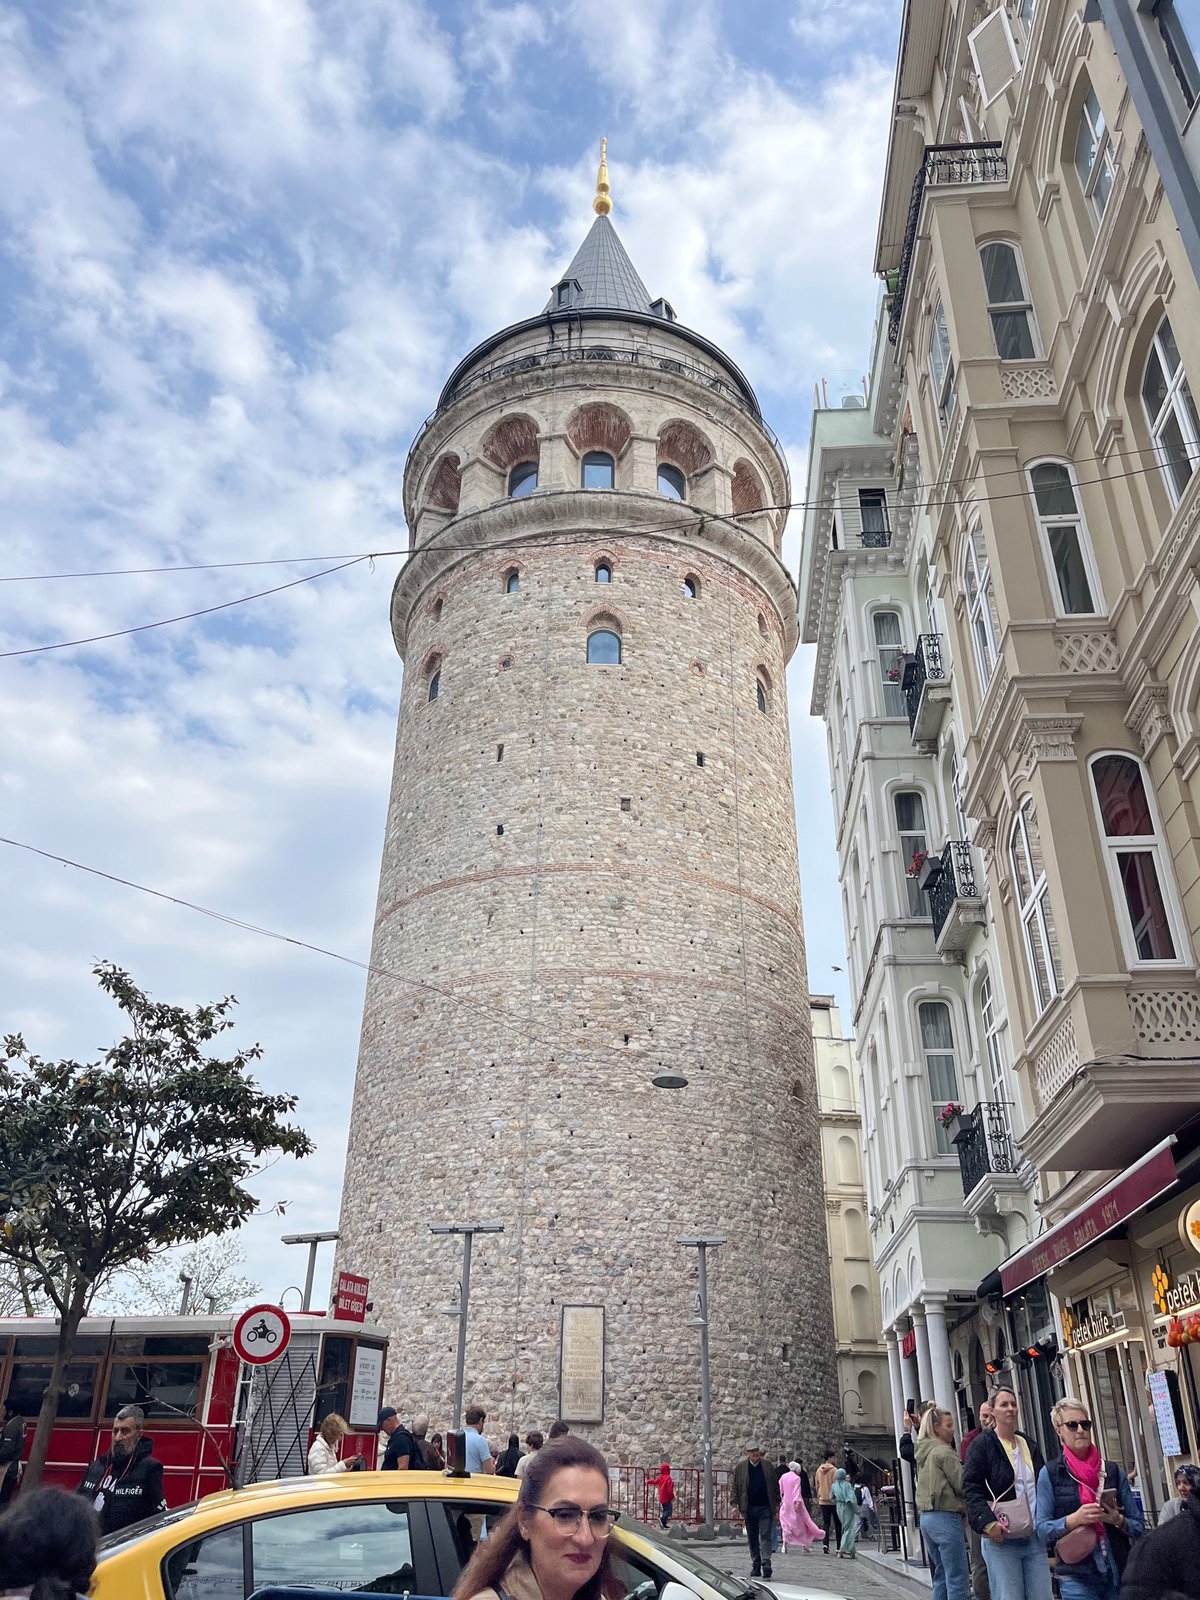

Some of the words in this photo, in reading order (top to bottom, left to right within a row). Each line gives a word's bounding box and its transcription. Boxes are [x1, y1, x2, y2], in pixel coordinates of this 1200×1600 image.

[1032, 1250, 1049, 1275] PETEK
[1074, 1217, 1099, 1247] GALATA
[1101, 1199, 1120, 1226] 1971
[339, 1279, 354, 1293] GALATA
[1166, 1275, 1198, 1316] petek
[1073, 1317, 1092, 1349] petek
[1091, 1311, 1110, 1338] büfe
[115, 1488, 143, 1496] HILFIGER
